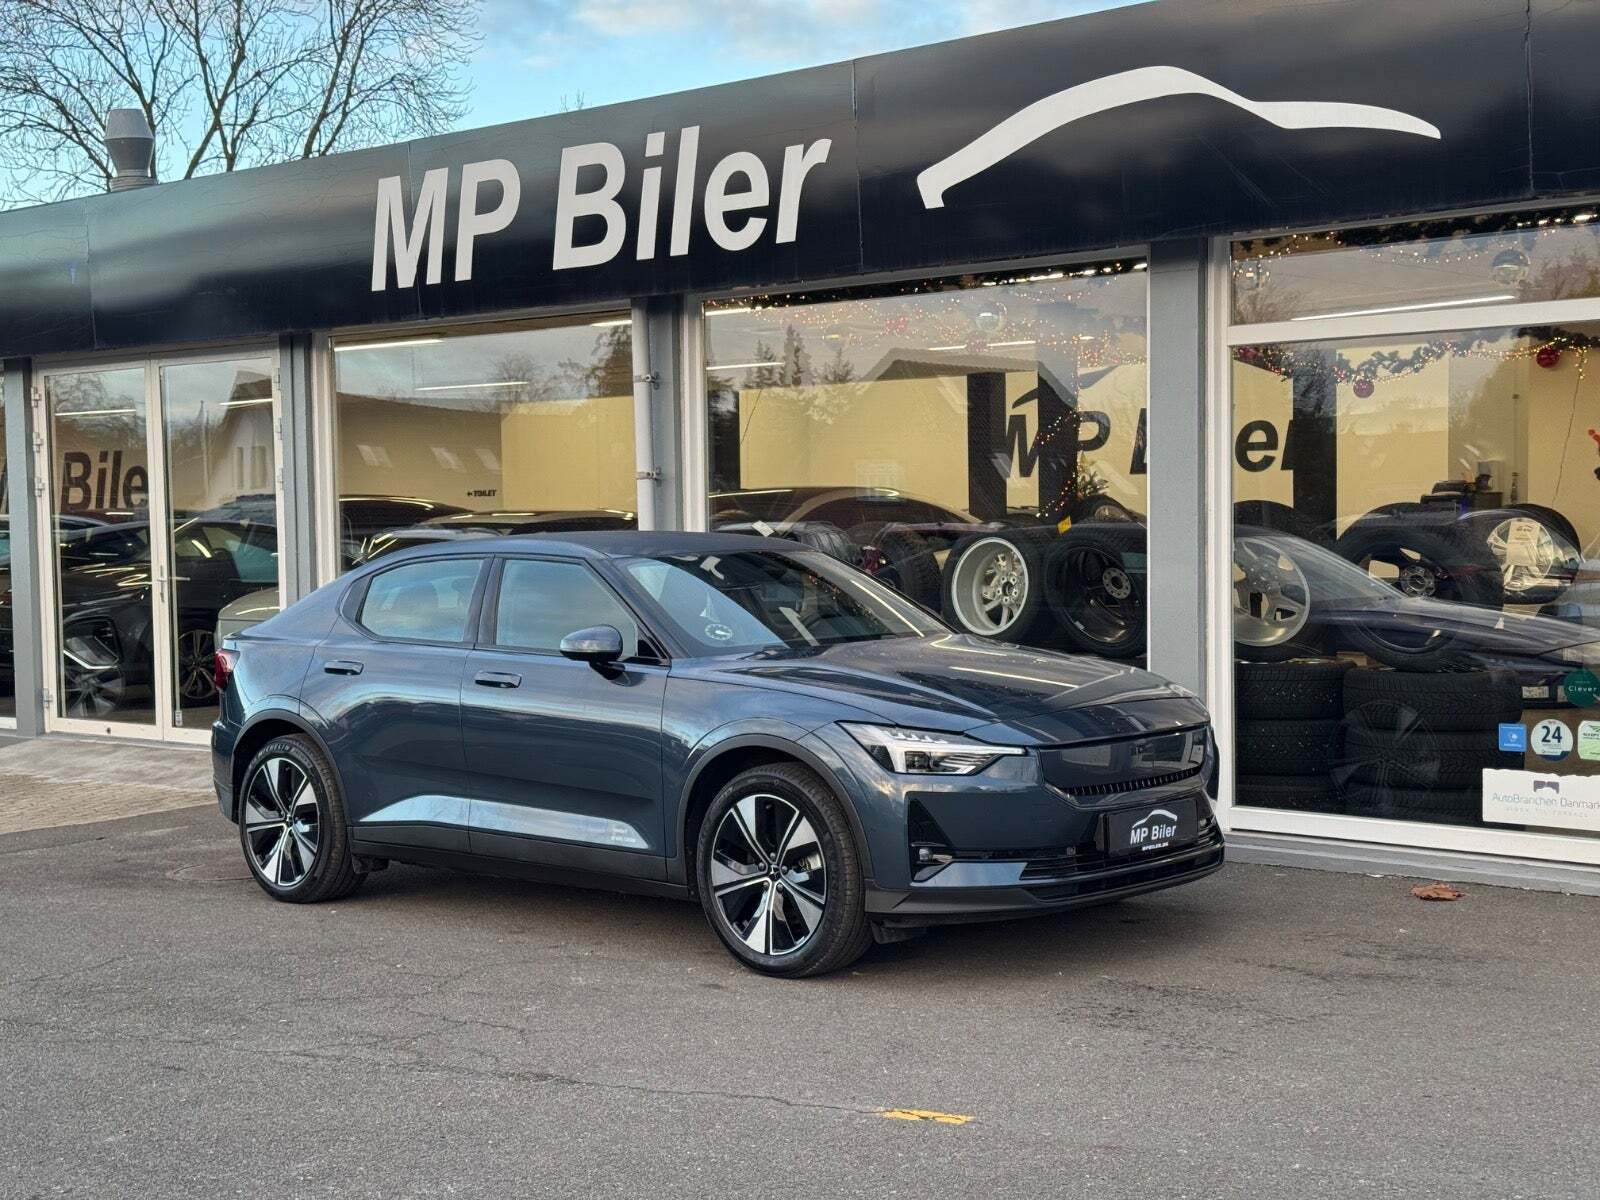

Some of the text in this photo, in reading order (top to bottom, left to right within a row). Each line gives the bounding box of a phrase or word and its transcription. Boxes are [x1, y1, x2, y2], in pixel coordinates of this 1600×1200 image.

[371, 125, 833, 292] MP Biler
[60, 450, 149, 513] Bile
[472, 489, 497, 497] TOILET
[1568, 685, 1598, 693] Clever
[1541, 725, 1562, 743] 24
[1492, 792, 1557, 806] AutoBranchen
[1130, 824, 1177, 845] MP Biler
